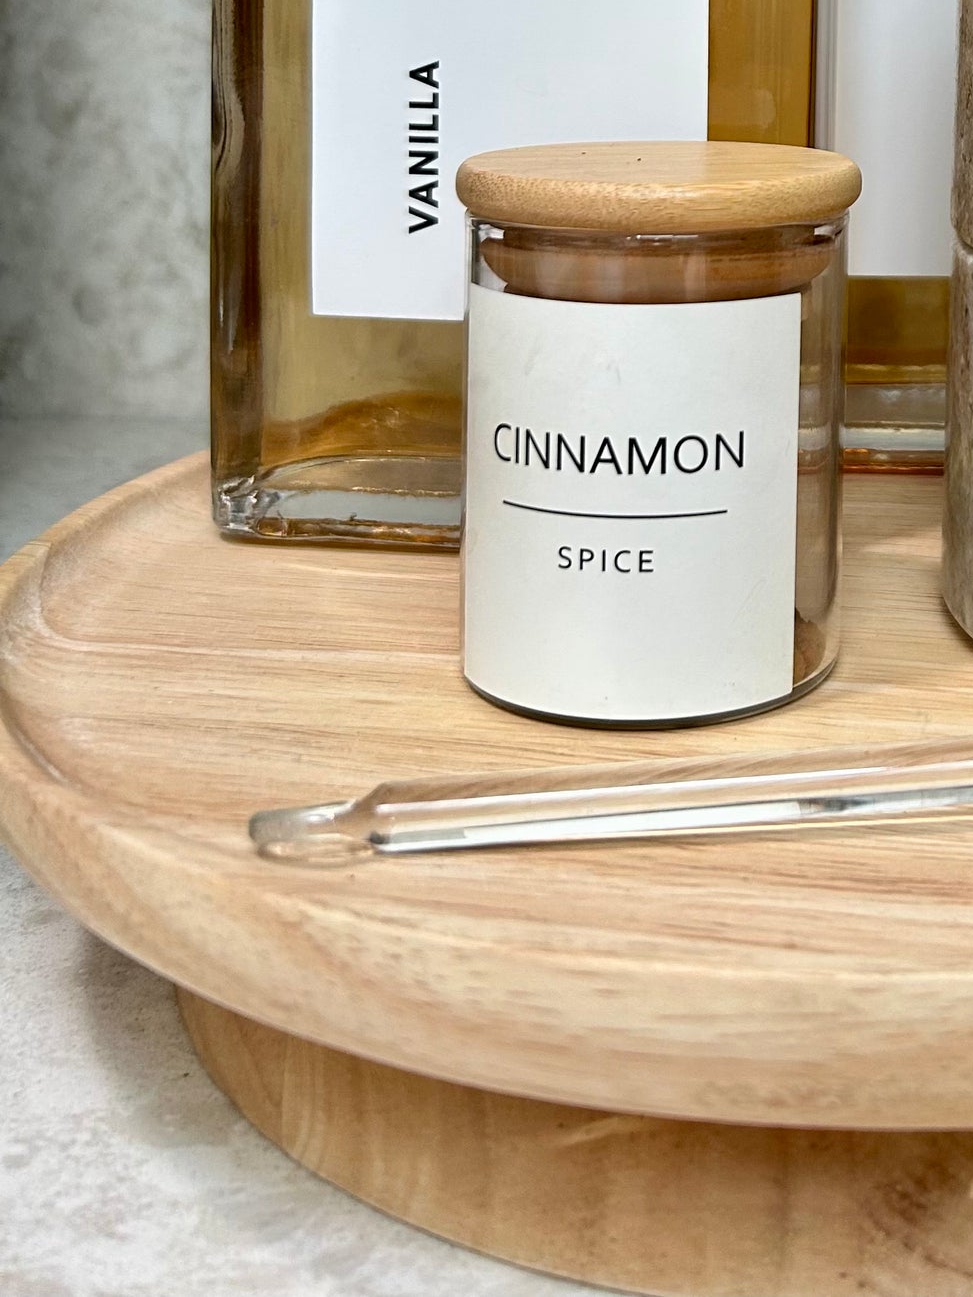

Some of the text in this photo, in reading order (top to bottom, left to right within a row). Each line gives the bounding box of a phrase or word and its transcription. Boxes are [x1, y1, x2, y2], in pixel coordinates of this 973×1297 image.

[407, 60, 441, 236] VANILLA
[493, 422, 746, 476] CINNAMON
[557, 545, 655, 574] SPICE
